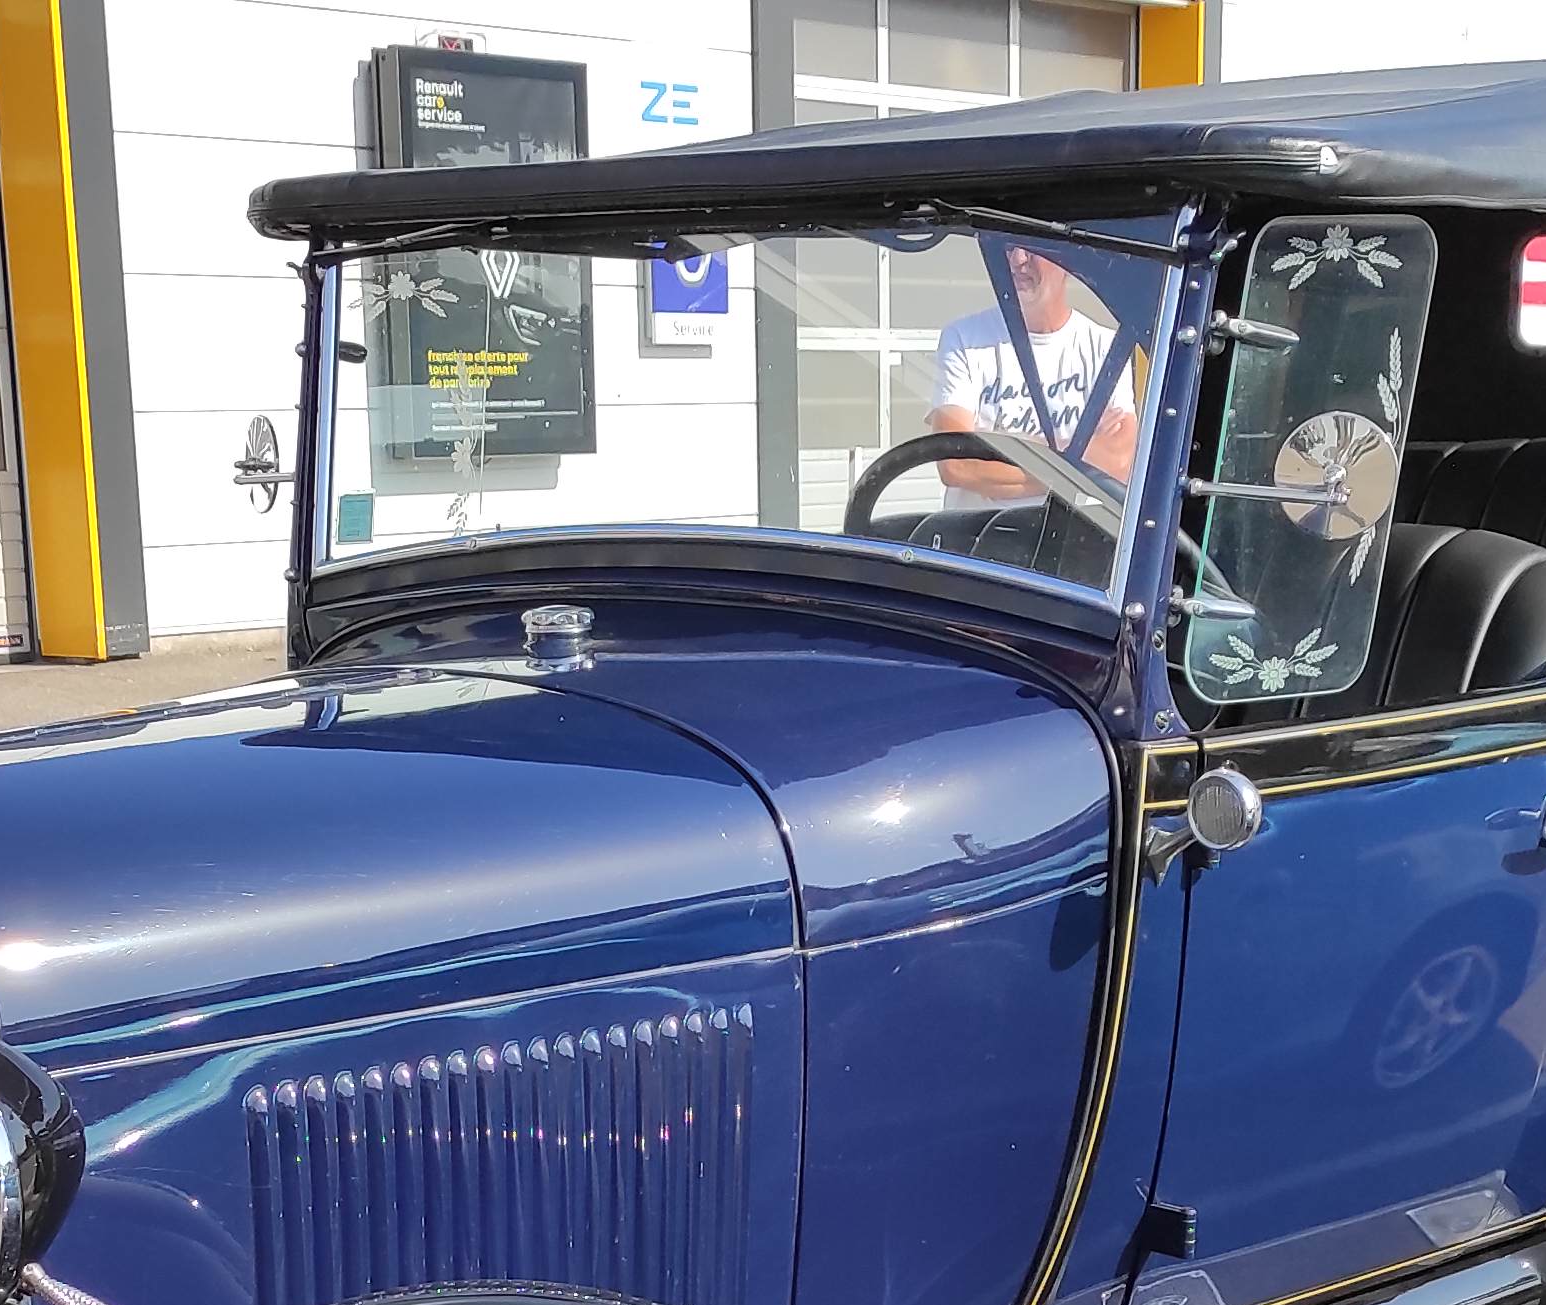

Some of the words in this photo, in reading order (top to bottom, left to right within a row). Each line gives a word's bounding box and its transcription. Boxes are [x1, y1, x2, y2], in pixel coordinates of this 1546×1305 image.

[415, 77, 464, 98] Renault
[416, 94, 445, 109] care
[417, 106, 463, 123] service
[507, 352, 529, 365] pour
[429, 364, 449, 375] tout
[430, 376, 442, 389] de
